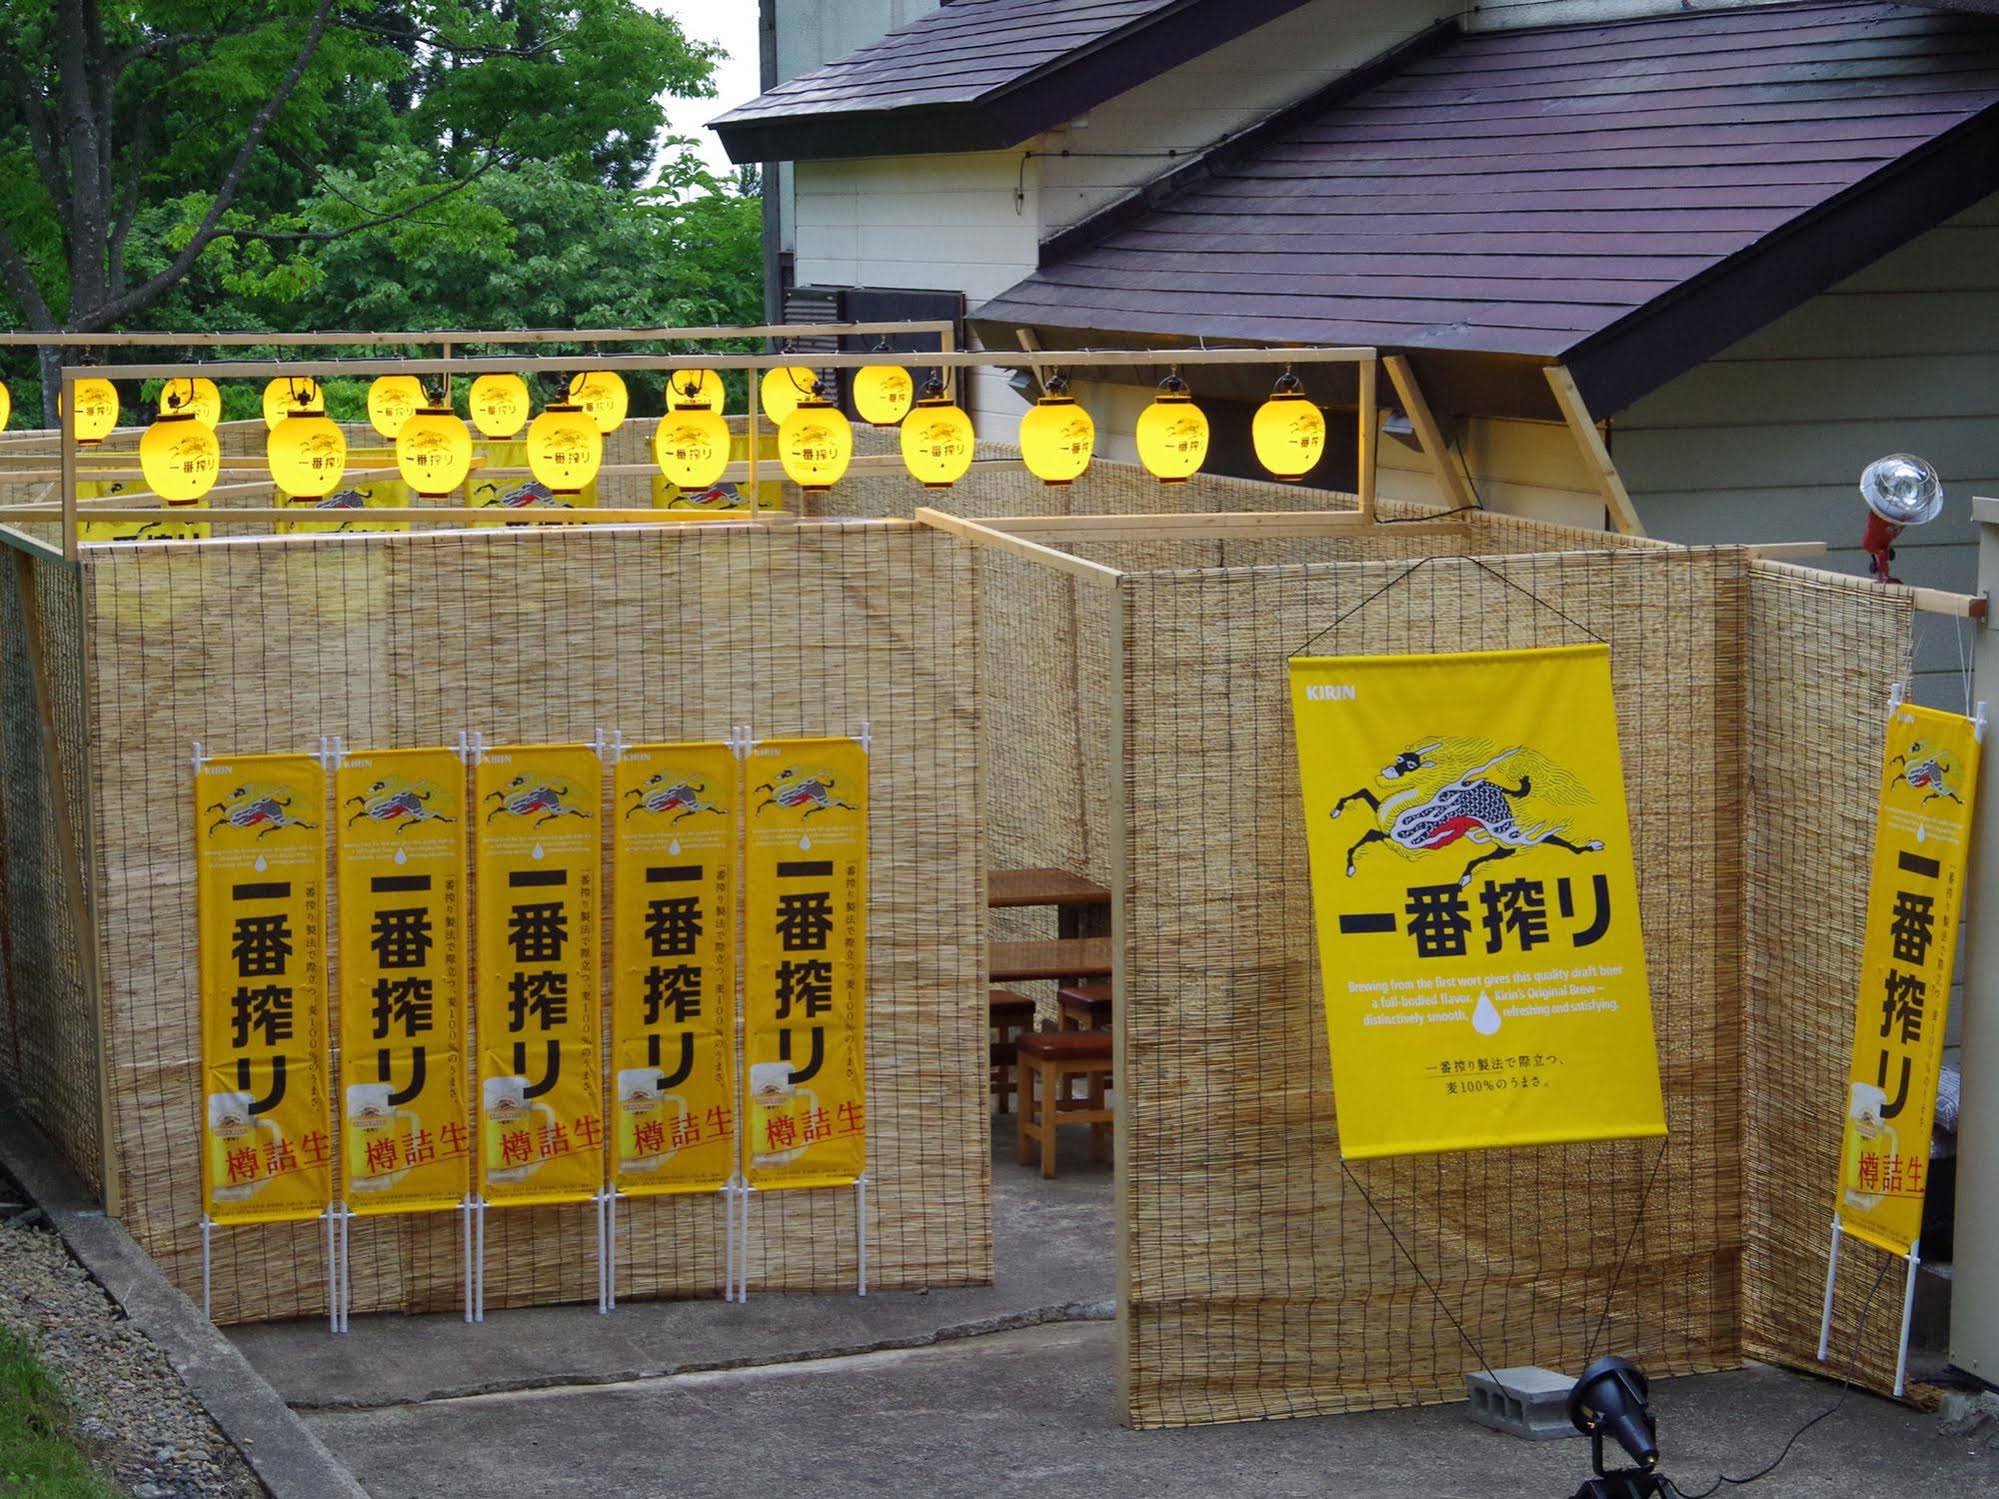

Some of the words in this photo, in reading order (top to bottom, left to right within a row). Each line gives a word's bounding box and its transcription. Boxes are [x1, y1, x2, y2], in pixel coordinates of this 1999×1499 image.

[298, 456, 346, 469] 一番搾り
[406, 454, 453, 466] 一番搾り
[543, 452, 590, 464] 一番搾り
[665, 448, 711, 459] 一番搾り
[792, 448, 838, 460] 一番搾り
[919, 444, 964, 457] 一番搾り
[169, 458, 214, 473] 一番搾り
[1306, 685, 1356, 701] KIRIN
[205, 766, 232, 775] KIRIN
[344, 761, 372, 769] KIRIN
[1339, 874, 1613, 959] 一番搾り
[507, 869, 568, 1099] 一番搾り
[643, 864, 703, 1091] 一番搾り
[775, 860, 834, 1085] 一番搾り
[1348, 980, 1388, 994] Brewing
[1391, 979, 1414, 990] from
[1417, 978, 1433, 989] the
[1435, 976, 1455, 987] first
[1458, 976, 1481, 986] wort
[1484, 973, 1510, 988] gives
[1513, 970, 1531, 982] this
[1535, 967, 1570, 982] quality
[1571, 964, 1597, 978] draft
[1599, 963, 1623, 976] beer
[1878, 850, 1941, 1120] 一番搾り
[231, 881, 293, 1116] 一番搾り
[370, 874, 433, 1106] 一番搾り
[1527, 986, 1568, 999] Original
[1363, 1012, 1424, 1026] distinctively
[1503, 1003, 1550, 1017] refreshing
[1552, 1002, 1568, 1013] and
[1425, 1053, 1566, 1074] 一番搾り製法で際立つ、
[1447, 1076, 1549, 1095] 麦100%のうまさ。
[632, 1104, 734, 1156] 樽詰生
[764, 1100, 866, 1151] 樽詰生
[365, 1121, 470, 1174] 樽詰生
[500, 1114, 602, 1166] 樽詰生
[225, 1130, 330, 1184] 樽詰生
[1858, 1151, 1925, 1193] 樽詰生
